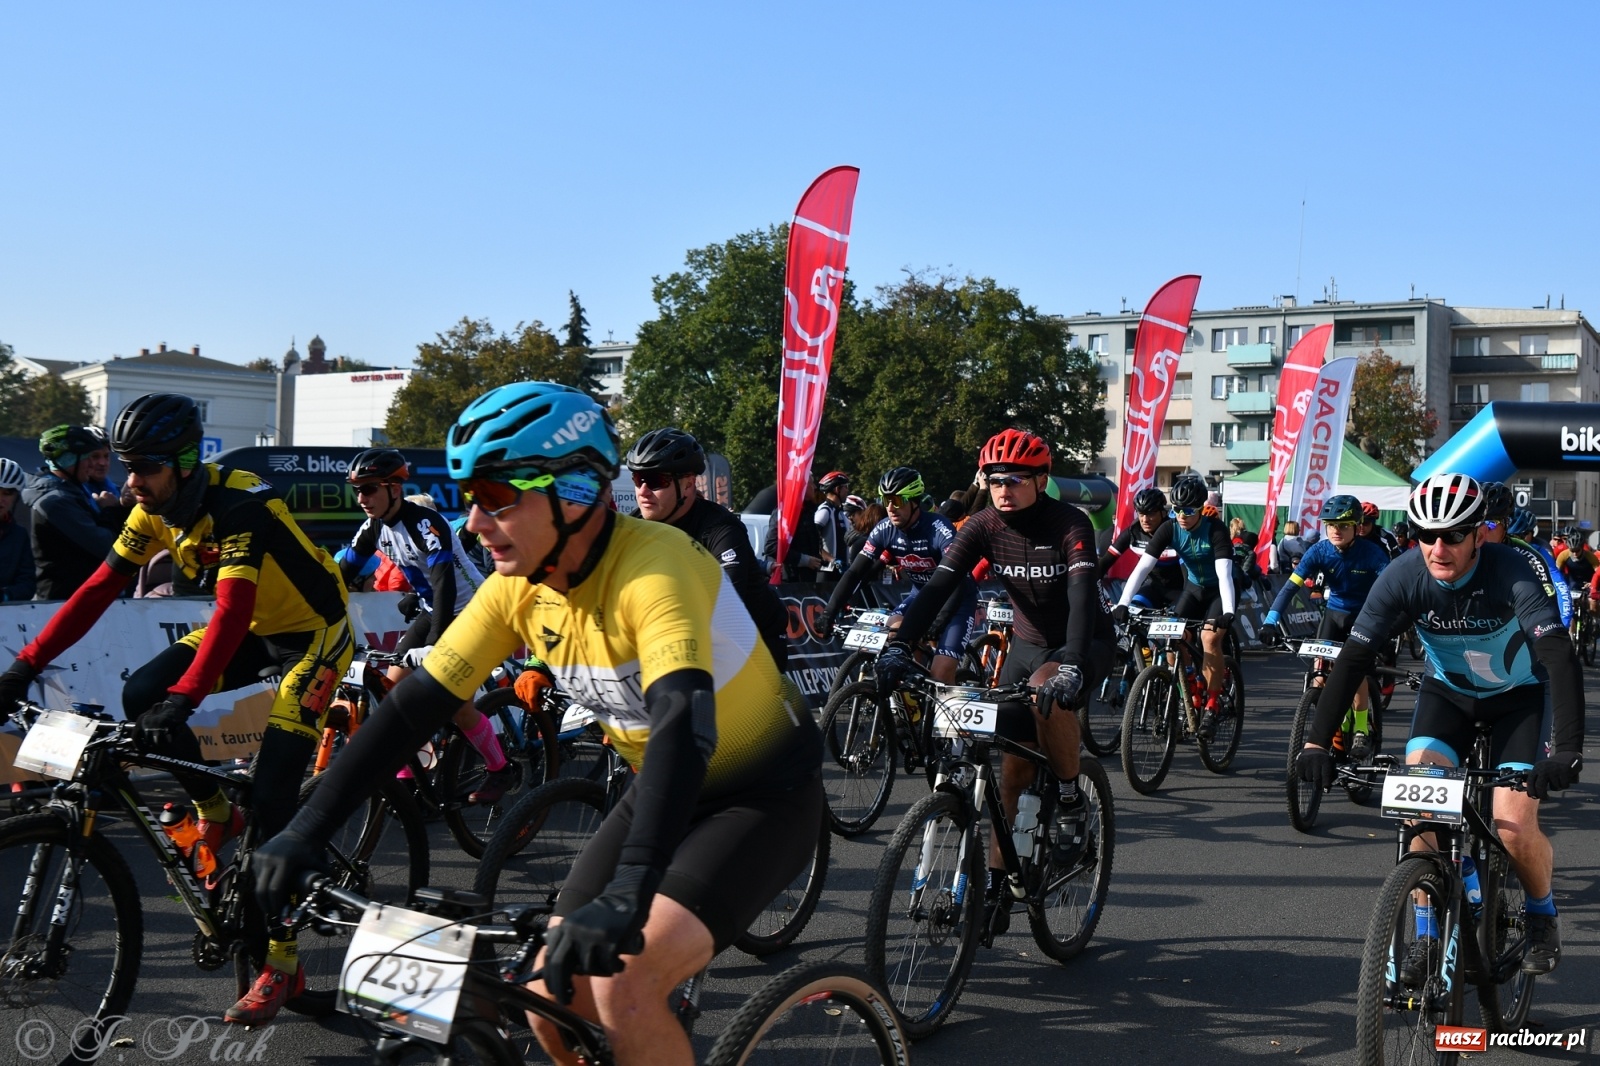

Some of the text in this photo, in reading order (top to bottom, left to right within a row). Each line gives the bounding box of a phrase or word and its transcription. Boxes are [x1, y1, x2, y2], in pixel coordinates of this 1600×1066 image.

[1560, 425, 1600, 451] bik
[1300, 378, 1341, 537] RACIBÓRZ
[1513, 546, 1548, 582] AUTHOR
[864, 614, 886, 623] 2196
[992, 610, 1012, 619] 3181
[1432, 614, 1504, 634] SutriSept
[1155, 624, 1179, 632] 2011
[853, 633, 880, 645] 3155
[1307, 645, 1334, 655] 1405
[1394, 783, 1449, 805] 2823
[362, 951, 445, 999] 2237
